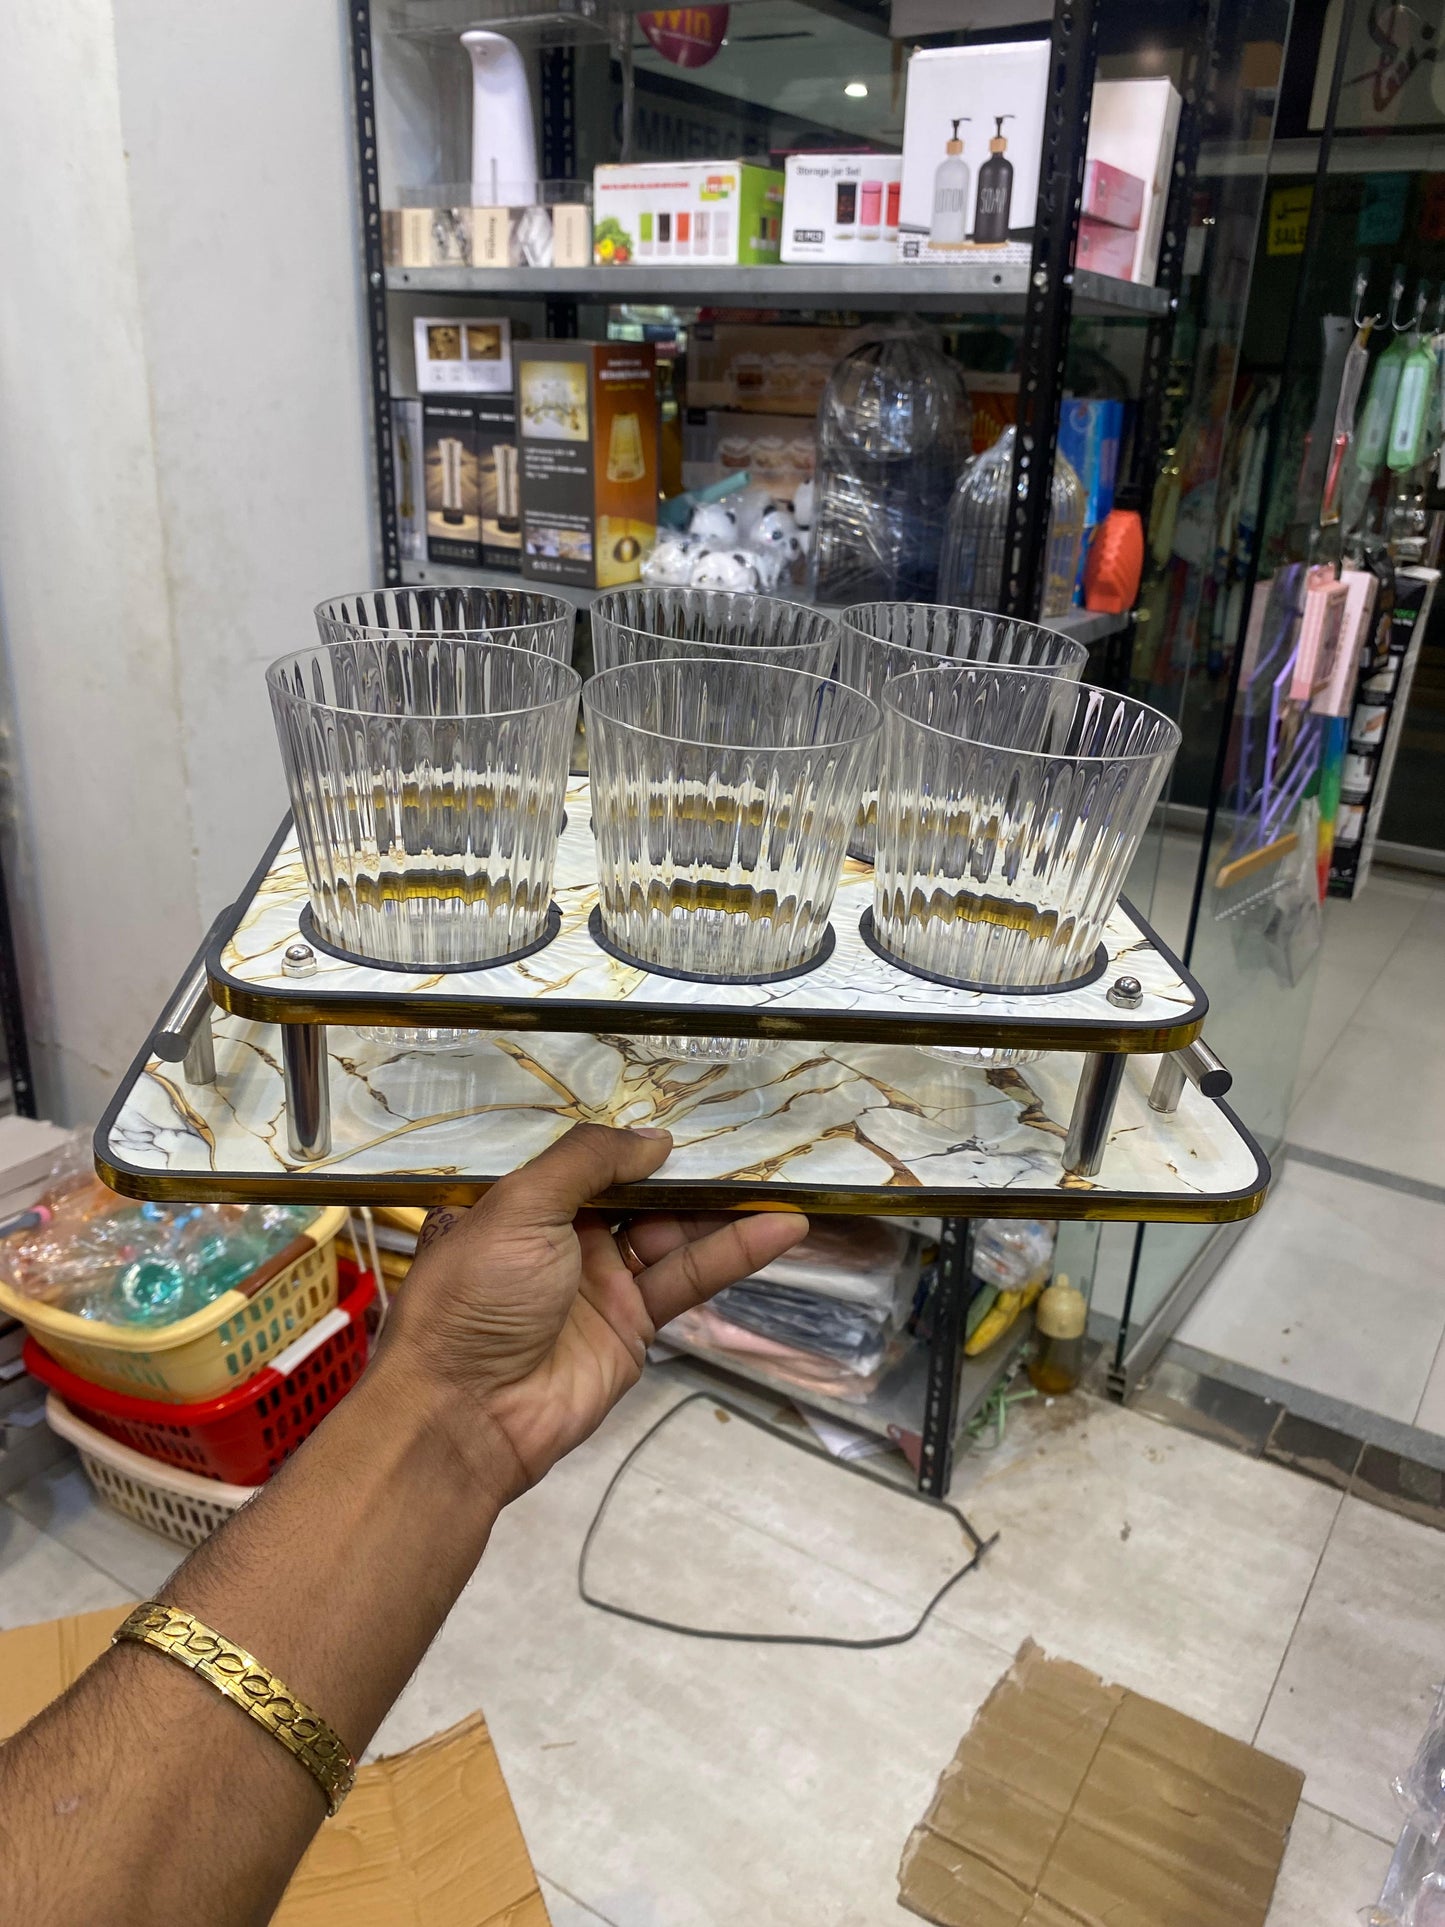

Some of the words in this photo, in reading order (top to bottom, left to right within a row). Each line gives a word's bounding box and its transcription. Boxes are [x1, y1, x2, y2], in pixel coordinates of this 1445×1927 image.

[796, 166, 829, 177] Storage
[979, 187, 1007, 214] SOAP
[1275, 226, 1305, 246] SALE
